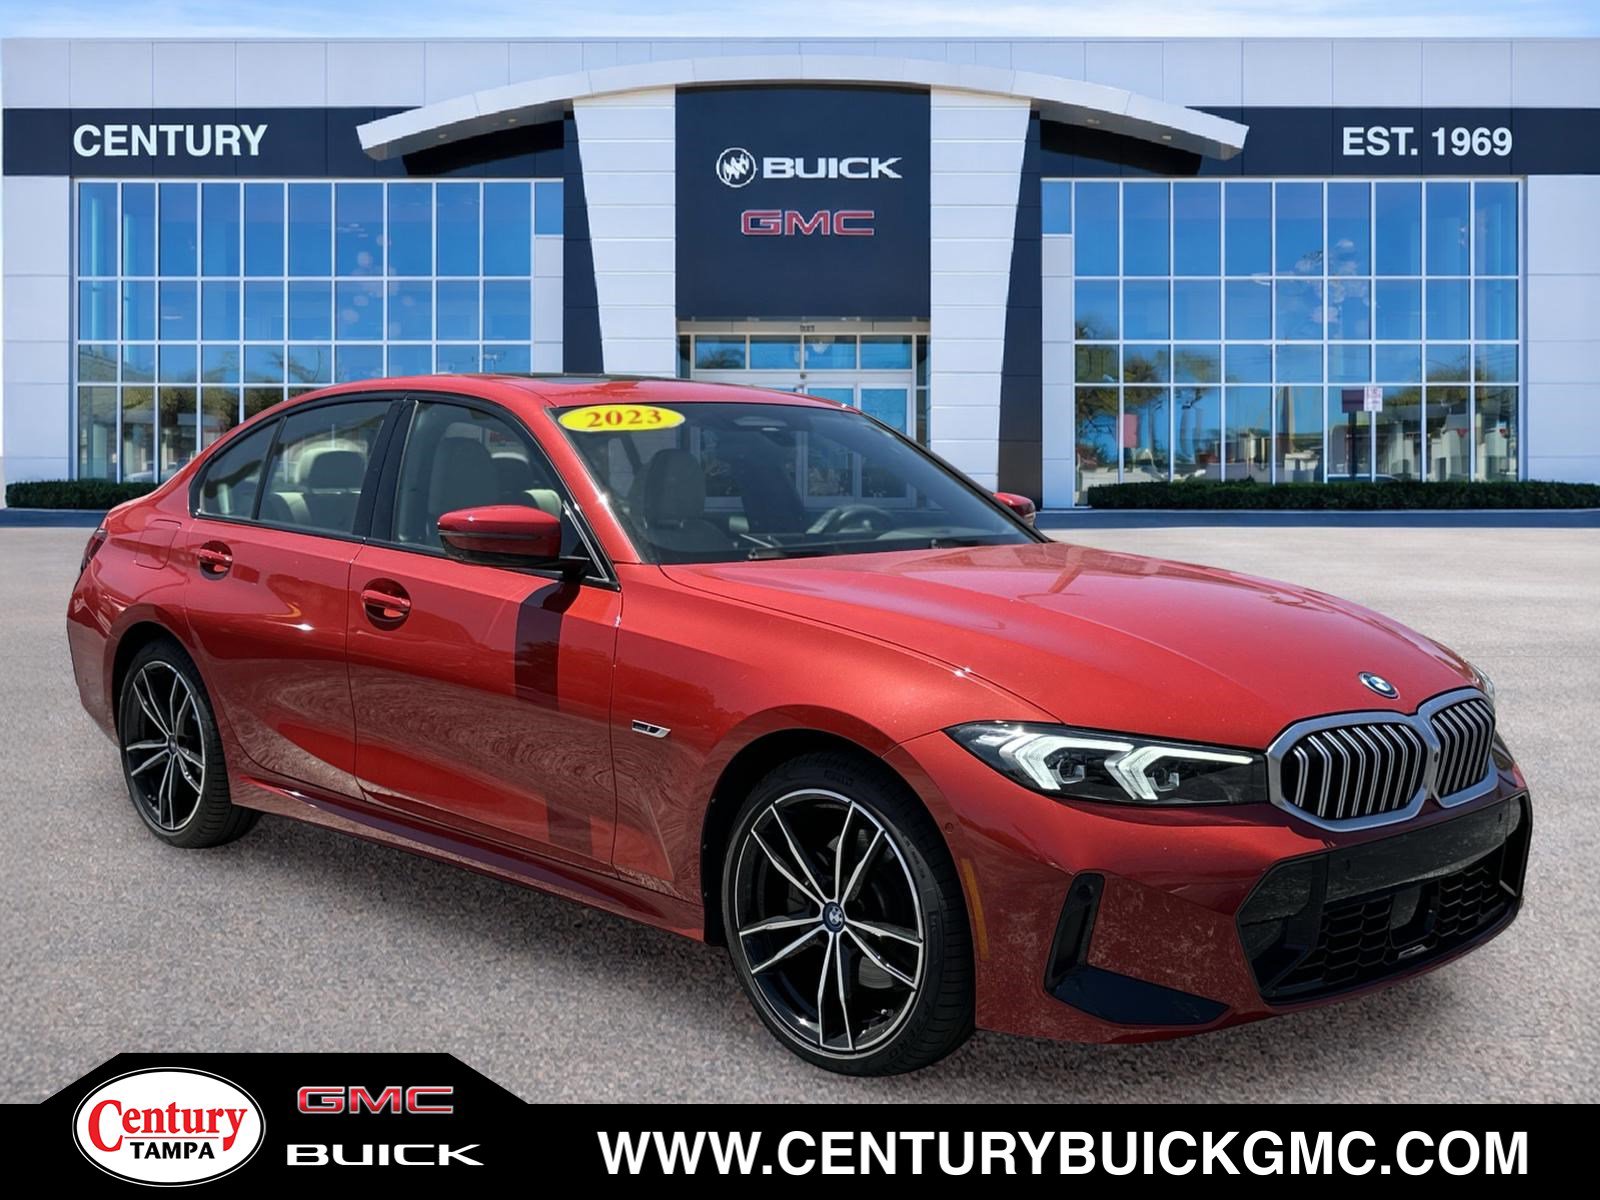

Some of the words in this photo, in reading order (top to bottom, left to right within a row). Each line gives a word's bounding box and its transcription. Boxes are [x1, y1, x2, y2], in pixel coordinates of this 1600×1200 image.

[73, 124, 268, 157] CENTURY
[1342, 126, 1418, 156] EST.
[1431, 126, 1513, 157] 1969
[762, 156, 903, 179] BUICK
[740, 209, 875, 236] GMC
[585, 408, 662, 428] 2023
